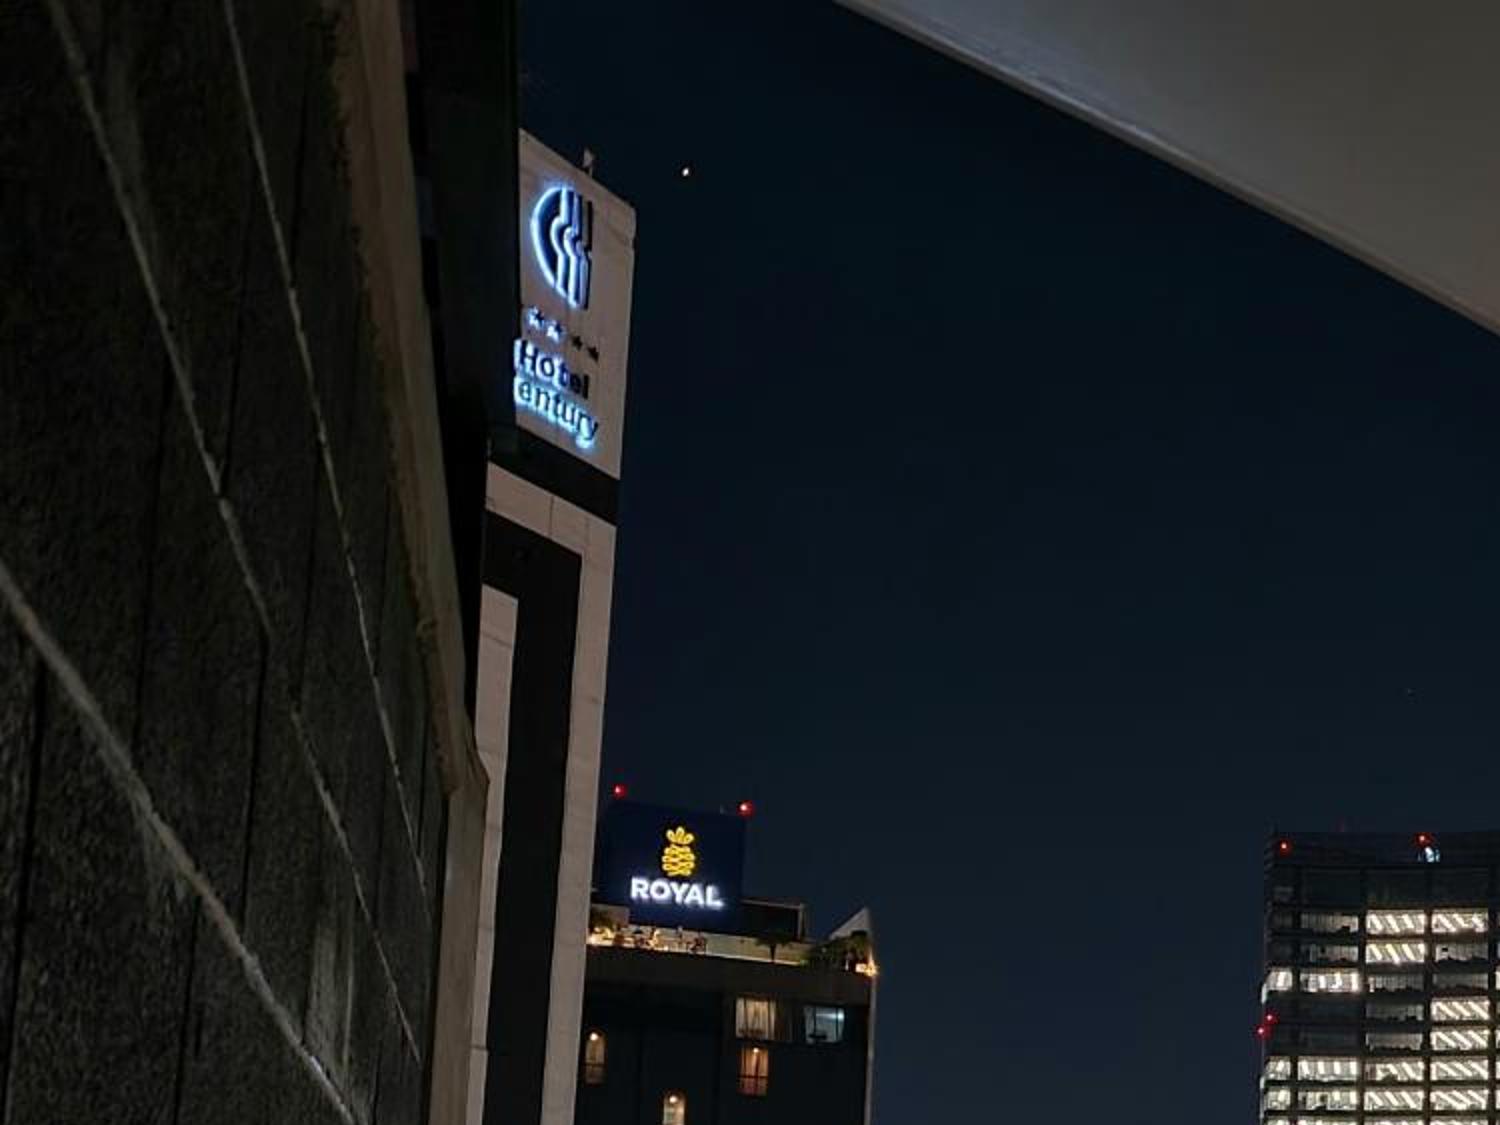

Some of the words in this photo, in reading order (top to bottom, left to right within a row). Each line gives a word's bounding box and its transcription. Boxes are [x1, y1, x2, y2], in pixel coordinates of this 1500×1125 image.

[516, 339, 589, 399] Hotel
[516, 380, 599, 443] entury
[630, 877, 724, 908] ROYAL
